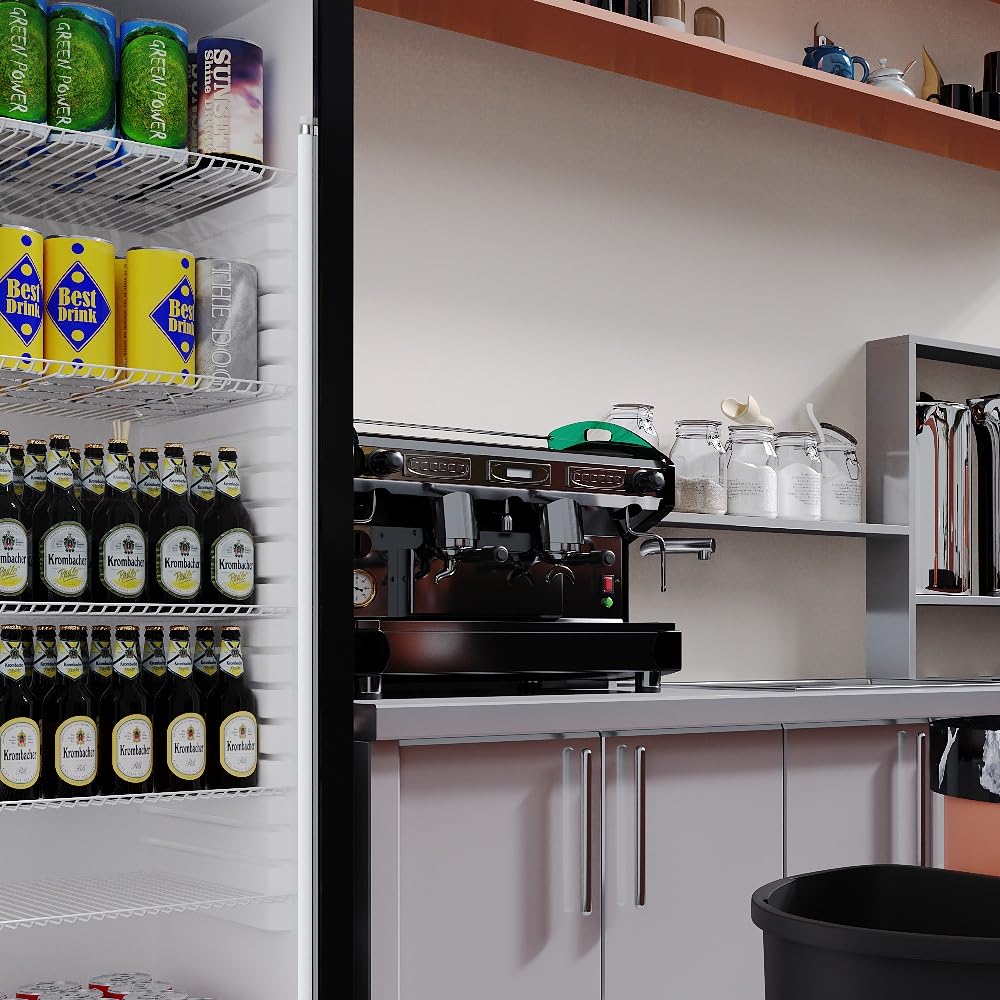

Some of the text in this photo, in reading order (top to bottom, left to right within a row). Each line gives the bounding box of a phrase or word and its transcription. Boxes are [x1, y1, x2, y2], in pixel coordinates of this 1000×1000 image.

[9, 7, 28, 113] GREEN POWER
[56, 22, 72, 126] GREEN POWER
[149, 39, 167, 140] GREEN POWER
[6, 278, 41, 303] Best
[58, 287, 97, 309] Best
[5, 298, 41, 319] Drink
[57, 306, 98, 324] Drink
[211, 262, 232, 386] THE DOG
[47, 553, 87, 566] Krombacher
[107, 555, 145, 568] Krombacher
[164, 557, 200, 569] Krombacher
[219, 558, 254, 570] Krombacher
[62, 746, 95, 759] Krombacher
[119, 744, 151, 756] Krombacher
[174, 742, 204, 754] Krombacher
[226, 740, 256, 752] Krombacher
[3, 749, 37, 760] Krombacher
